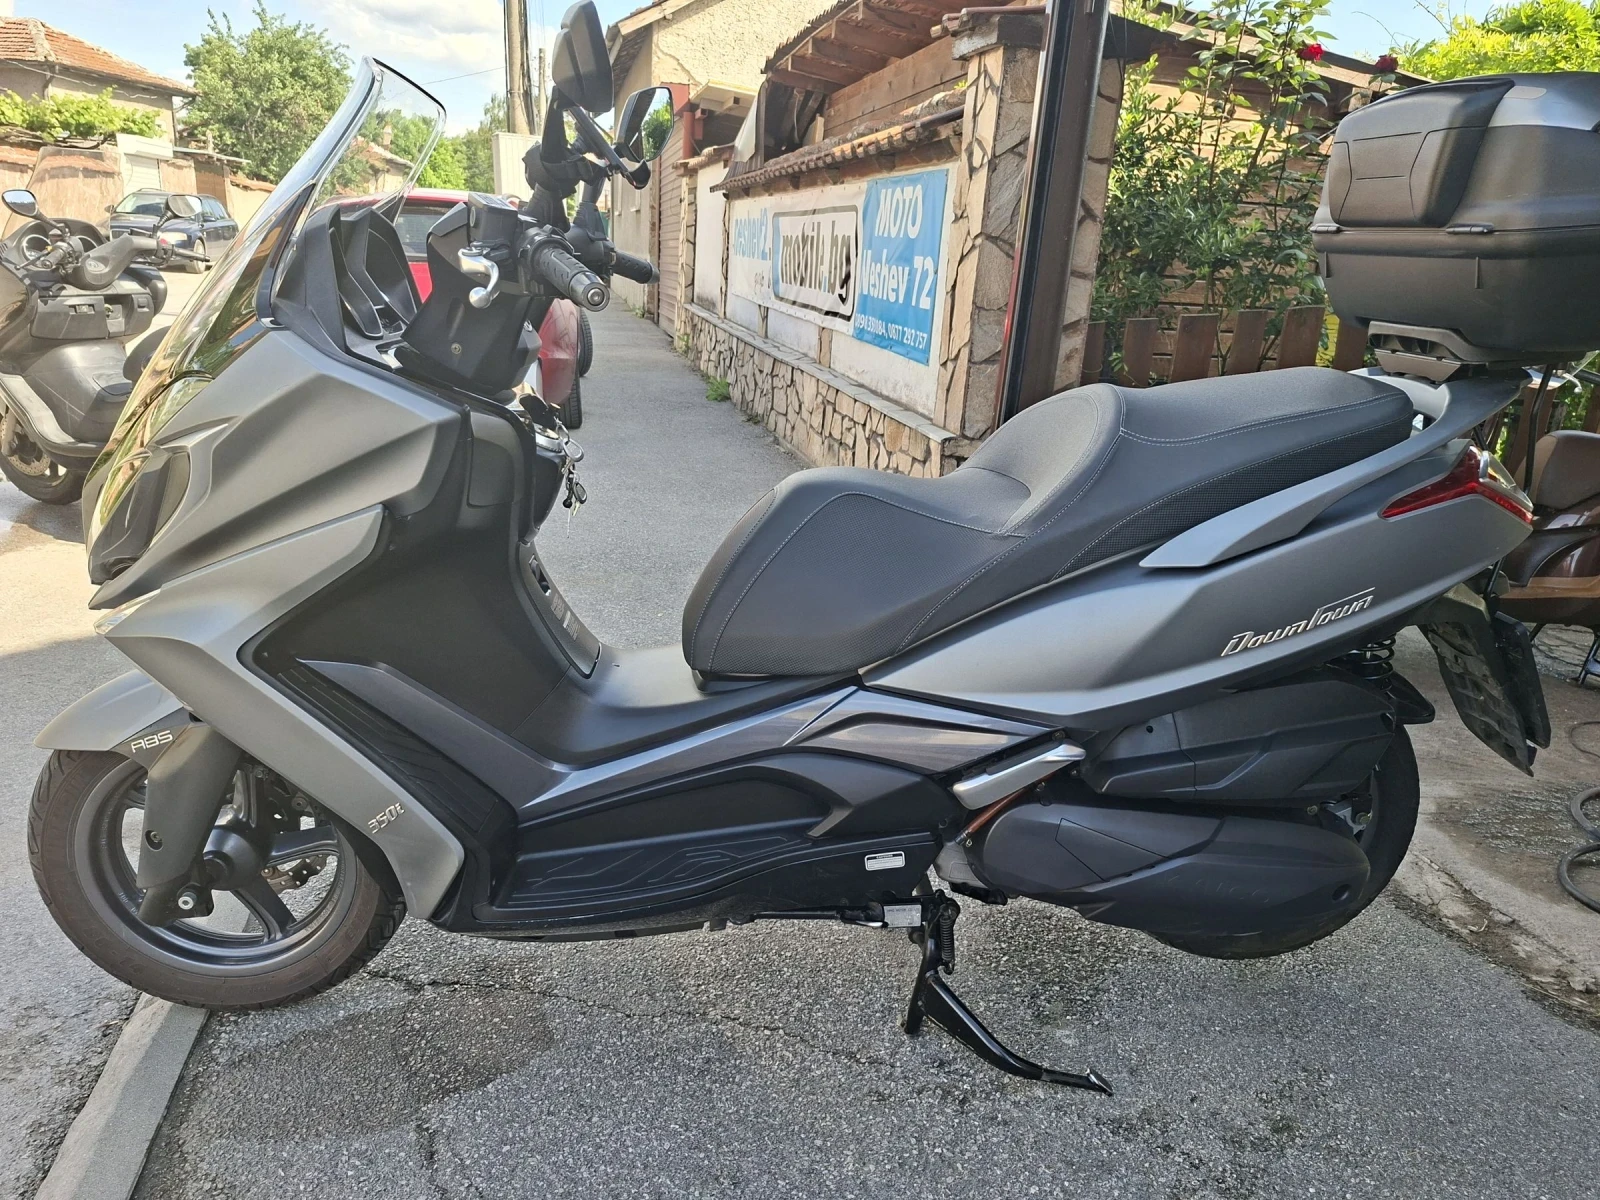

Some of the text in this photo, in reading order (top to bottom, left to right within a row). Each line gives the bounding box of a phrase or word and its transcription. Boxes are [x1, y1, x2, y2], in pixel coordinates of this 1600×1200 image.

[875, 184, 923, 239] MOTO
[781, 220, 851, 306] mobile.bg
[911, 255, 934, 310] 72
[130, 730, 173, 753] ABS
[367, 802, 405, 834] 350i
